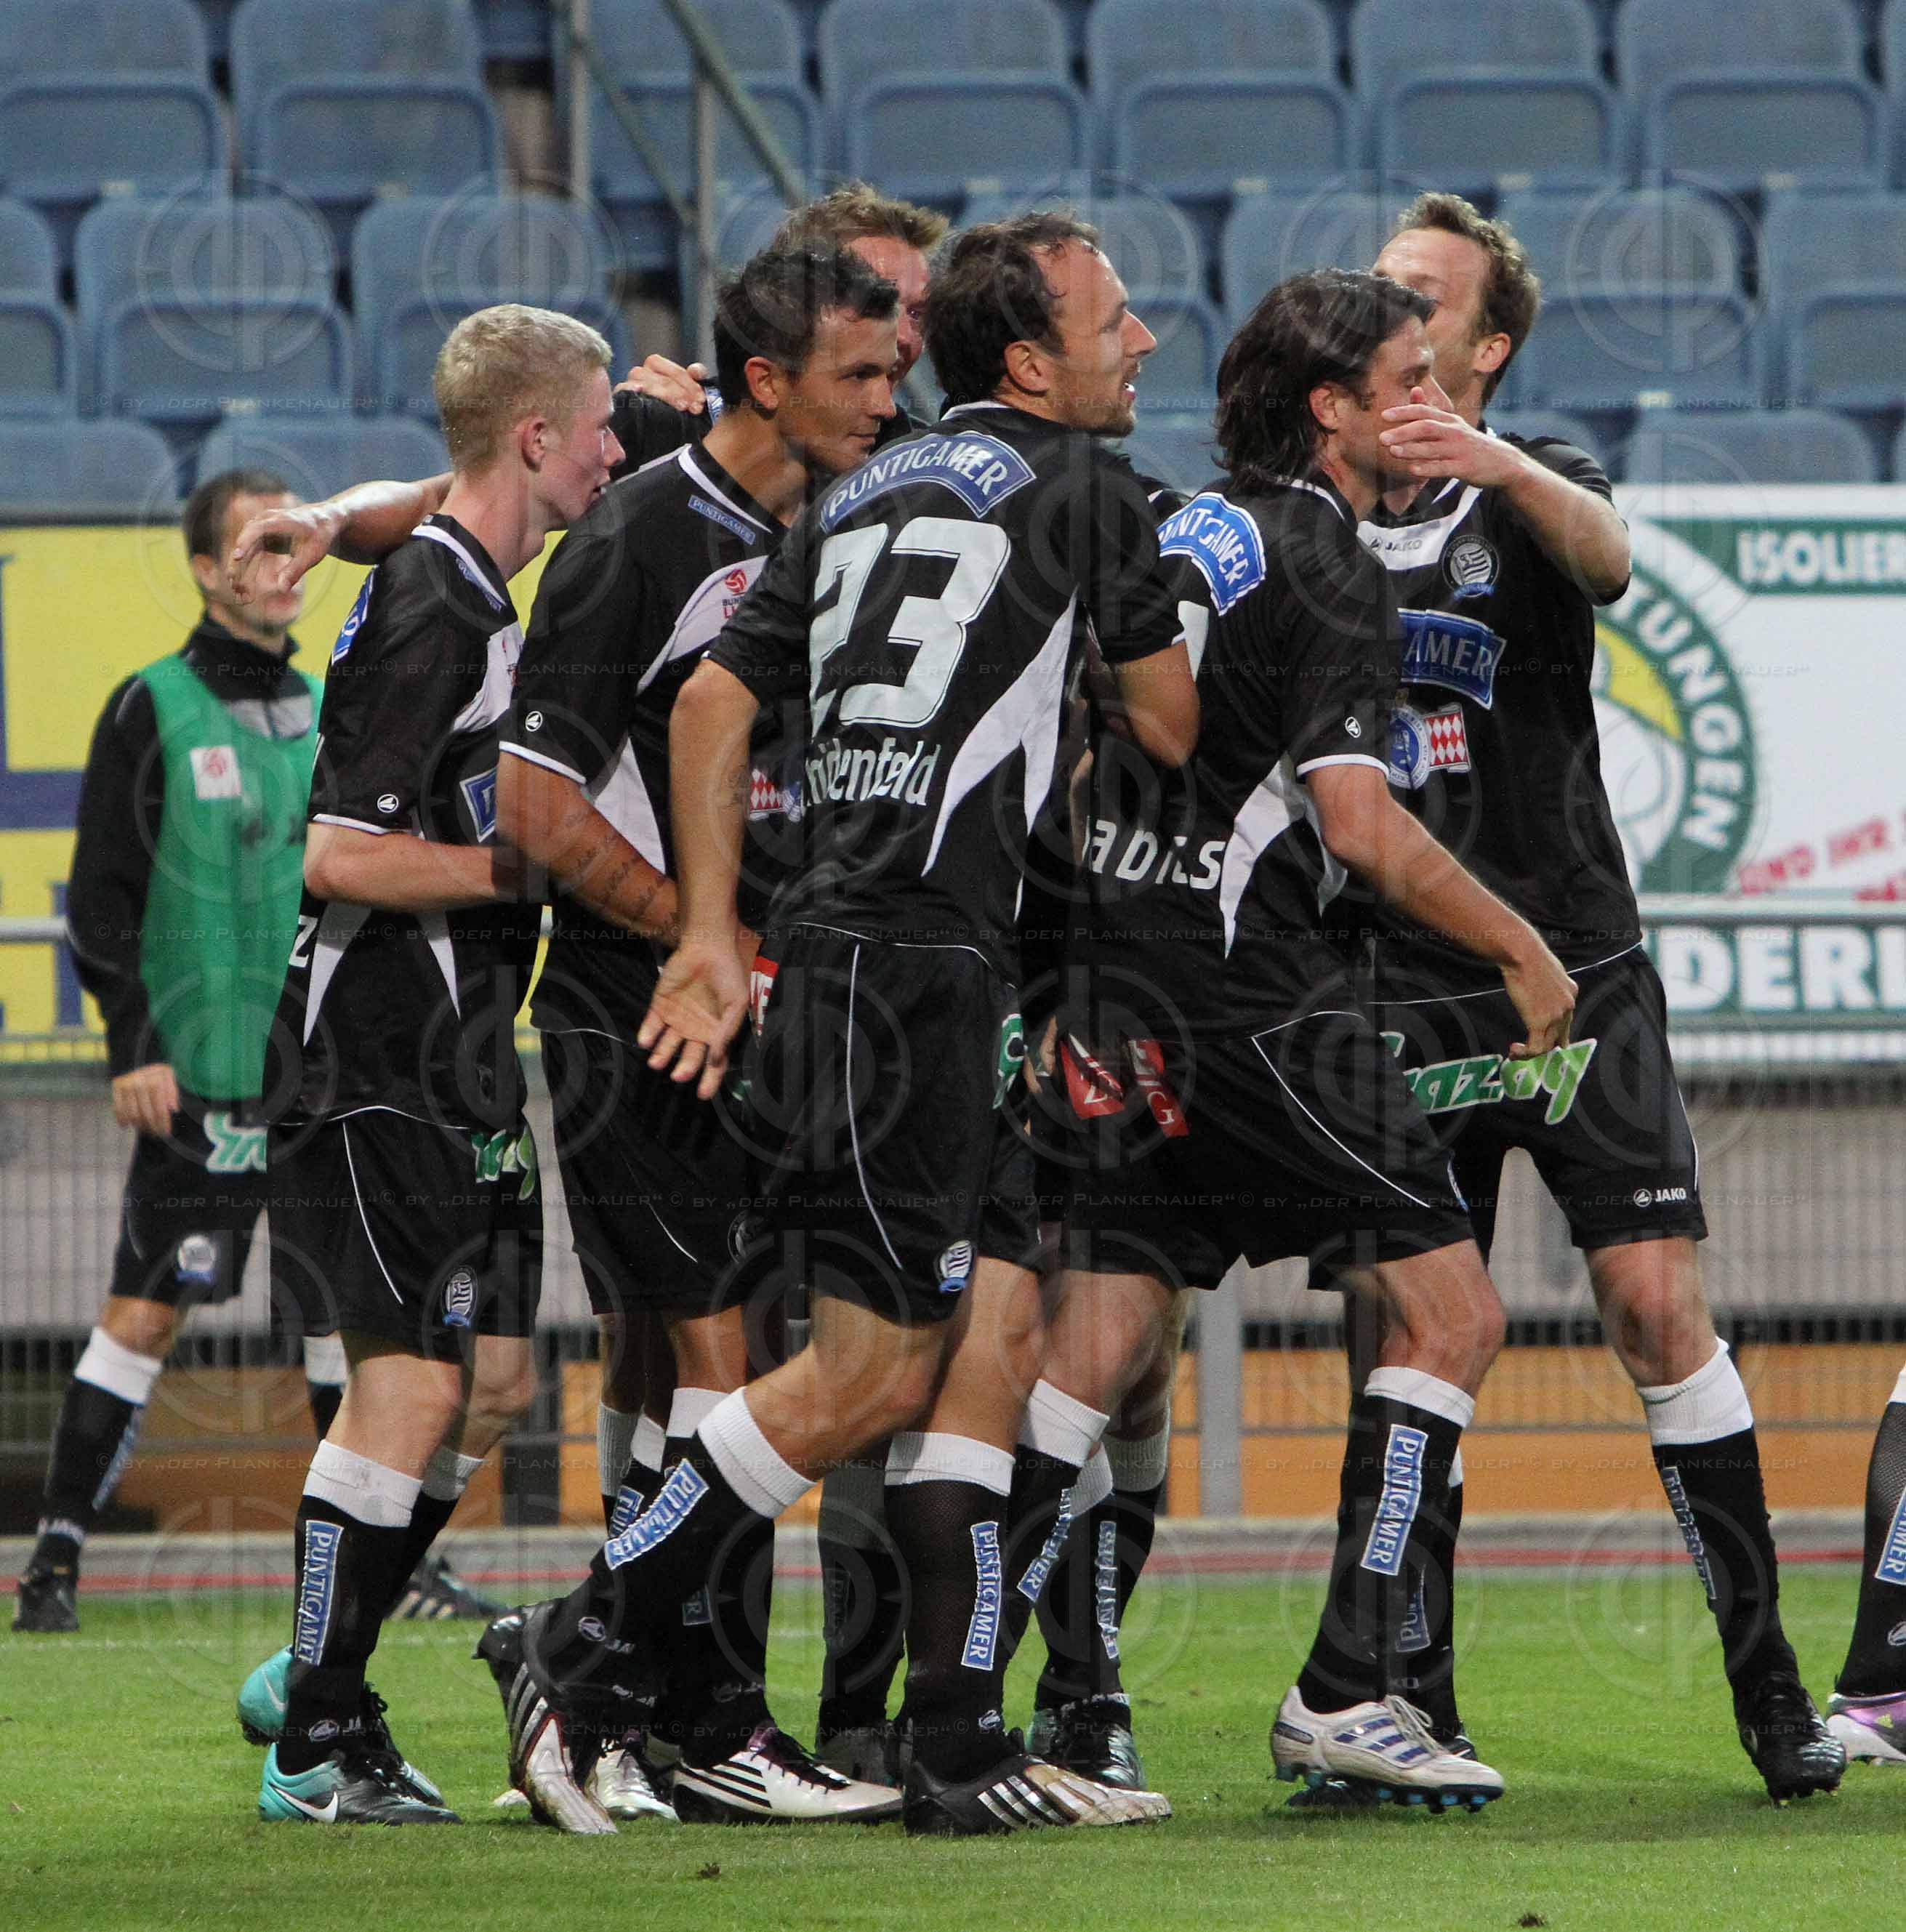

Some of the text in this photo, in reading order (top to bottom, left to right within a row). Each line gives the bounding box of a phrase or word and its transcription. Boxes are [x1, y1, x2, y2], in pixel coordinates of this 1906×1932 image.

[827, 440, 1008, 518] PUNTIGAMER
[809, 516, 1011, 738] 23
[1655, 1188, 1686, 1203] JAKO
[1372, 1435, 1419, 1565] PUNTIGAMER
